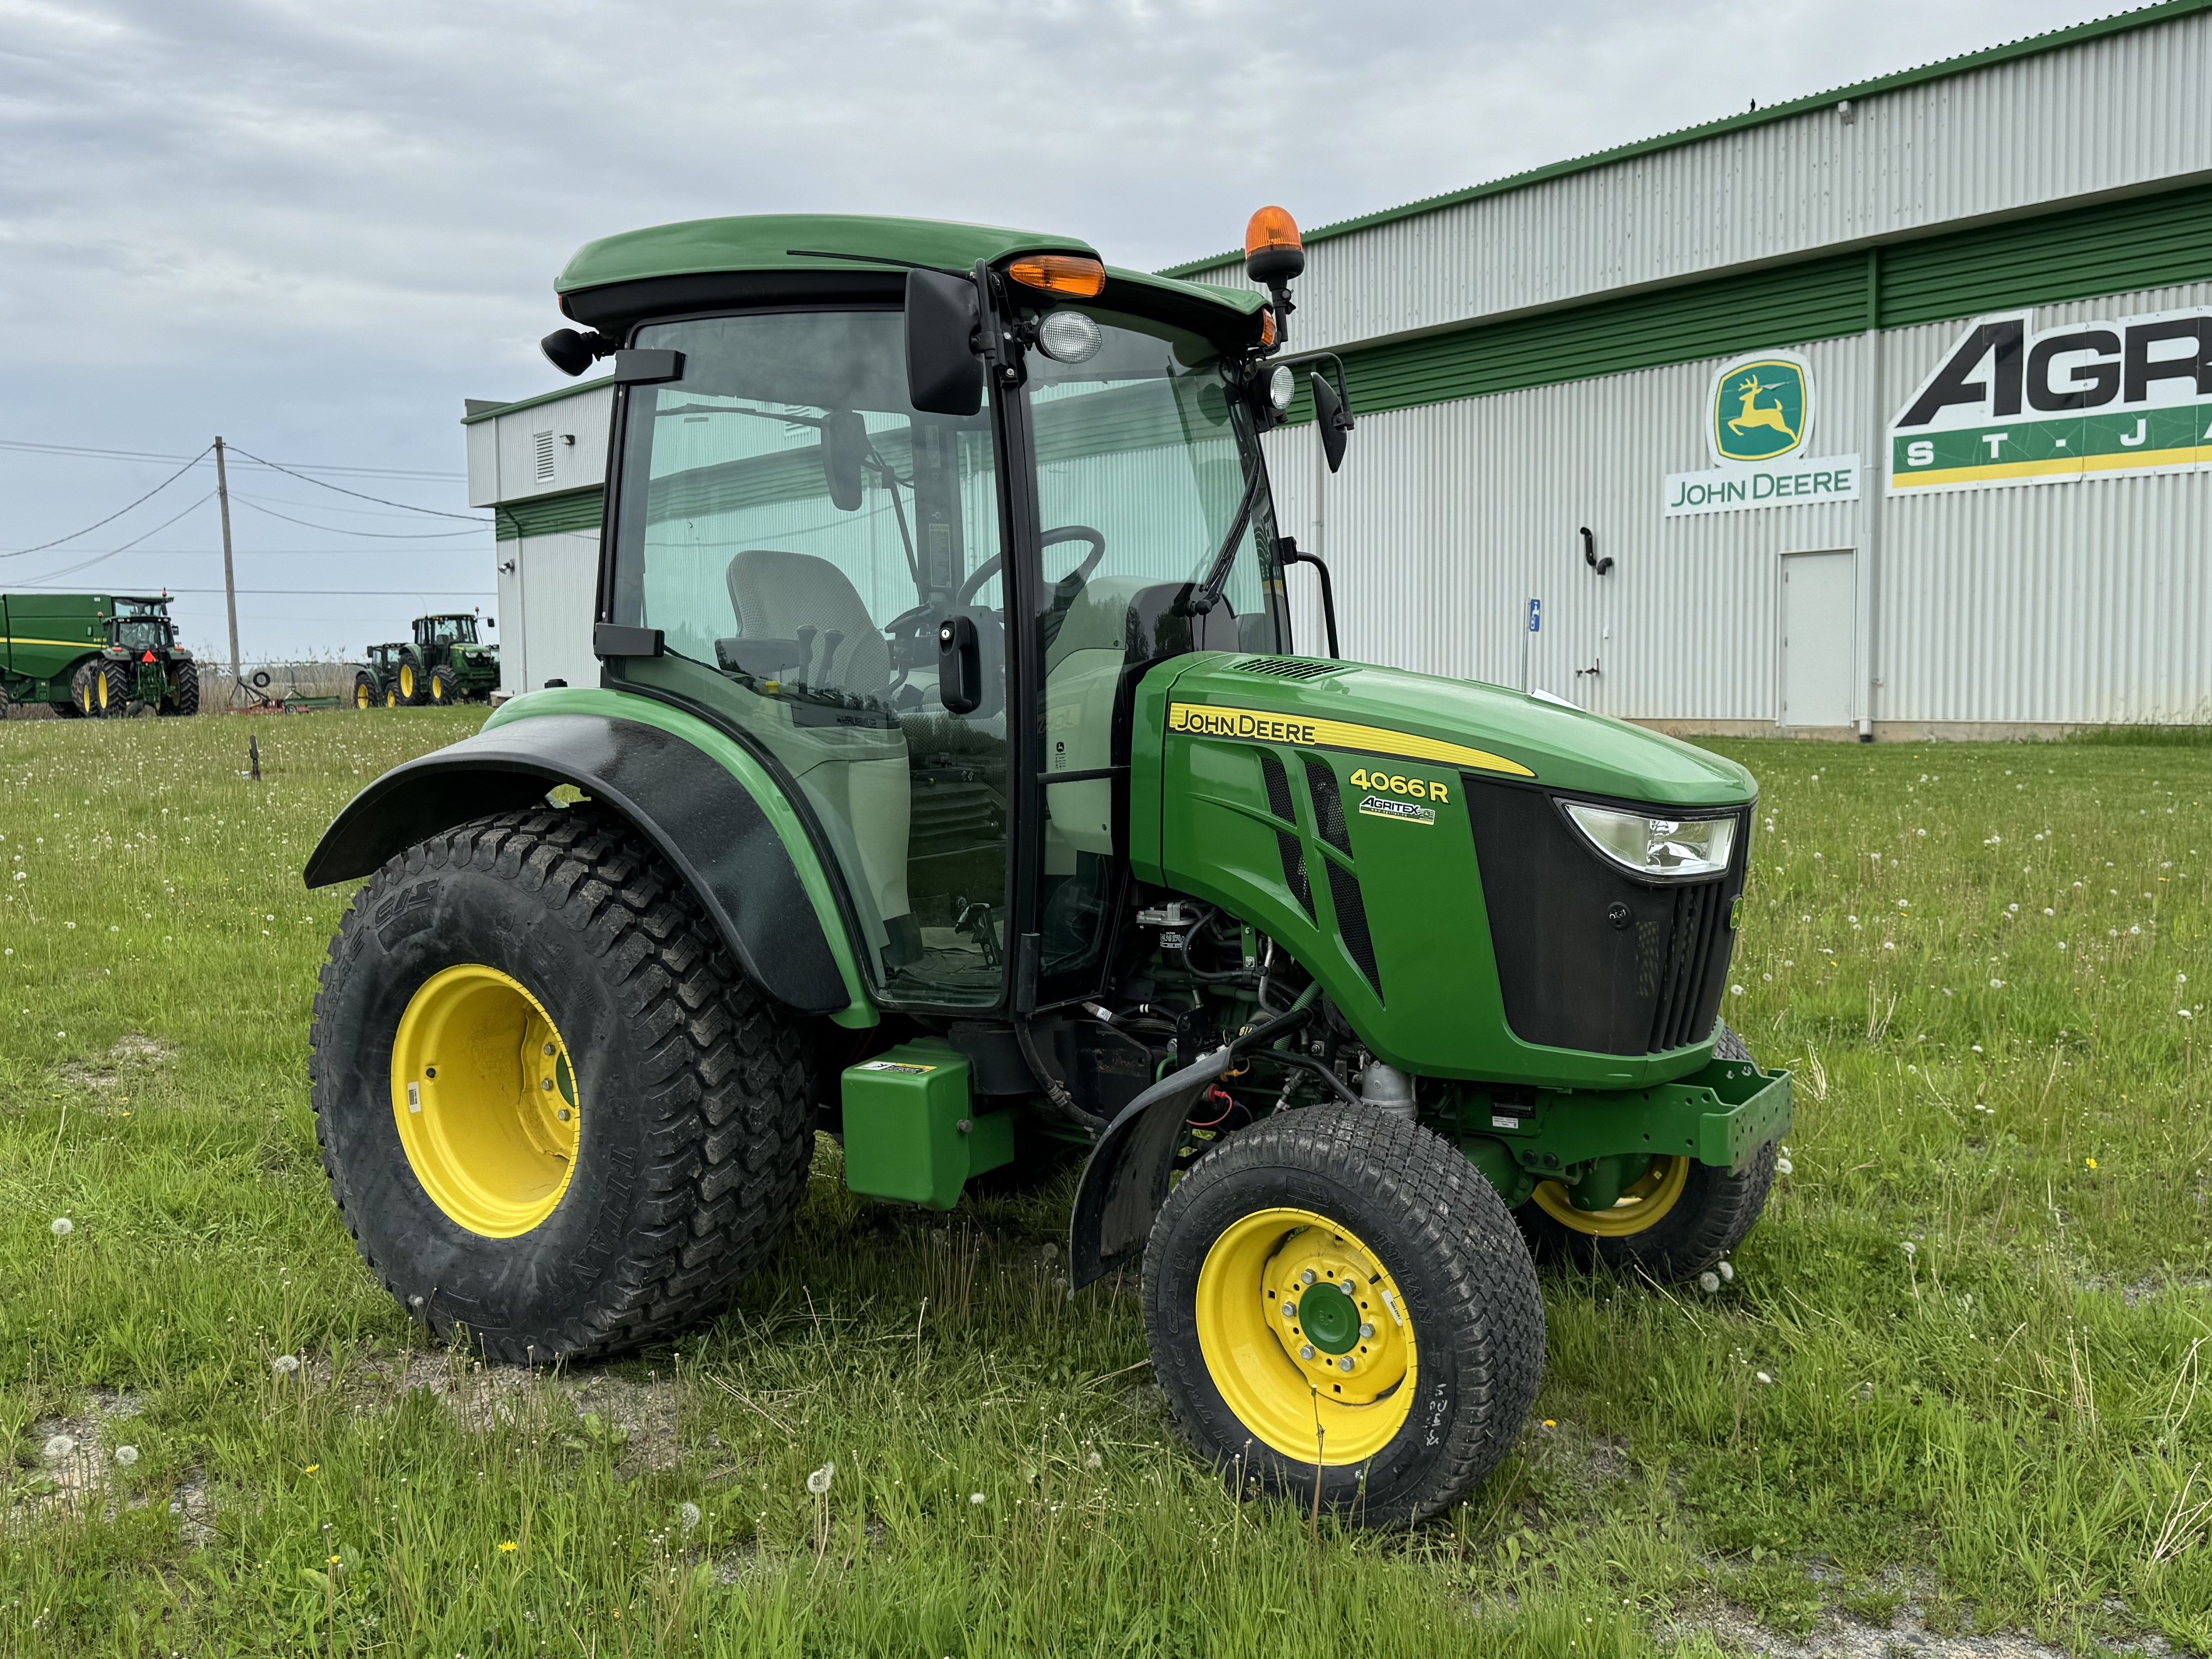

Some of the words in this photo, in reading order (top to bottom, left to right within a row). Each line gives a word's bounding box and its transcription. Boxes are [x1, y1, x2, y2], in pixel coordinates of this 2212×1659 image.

[1894, 316, 2212, 428] AGR
[1670, 480, 1746, 508] JOHN
[1753, 469, 1852, 499] DEERE
[1177, 709, 1235, 734] JOHN
[1238, 715, 1315, 743] DEERE
[1361, 797, 1419, 814] AGRITEX
[572, 1143, 639, 1293] TITAN
[1373, 1229, 1433, 1324] TITAN
